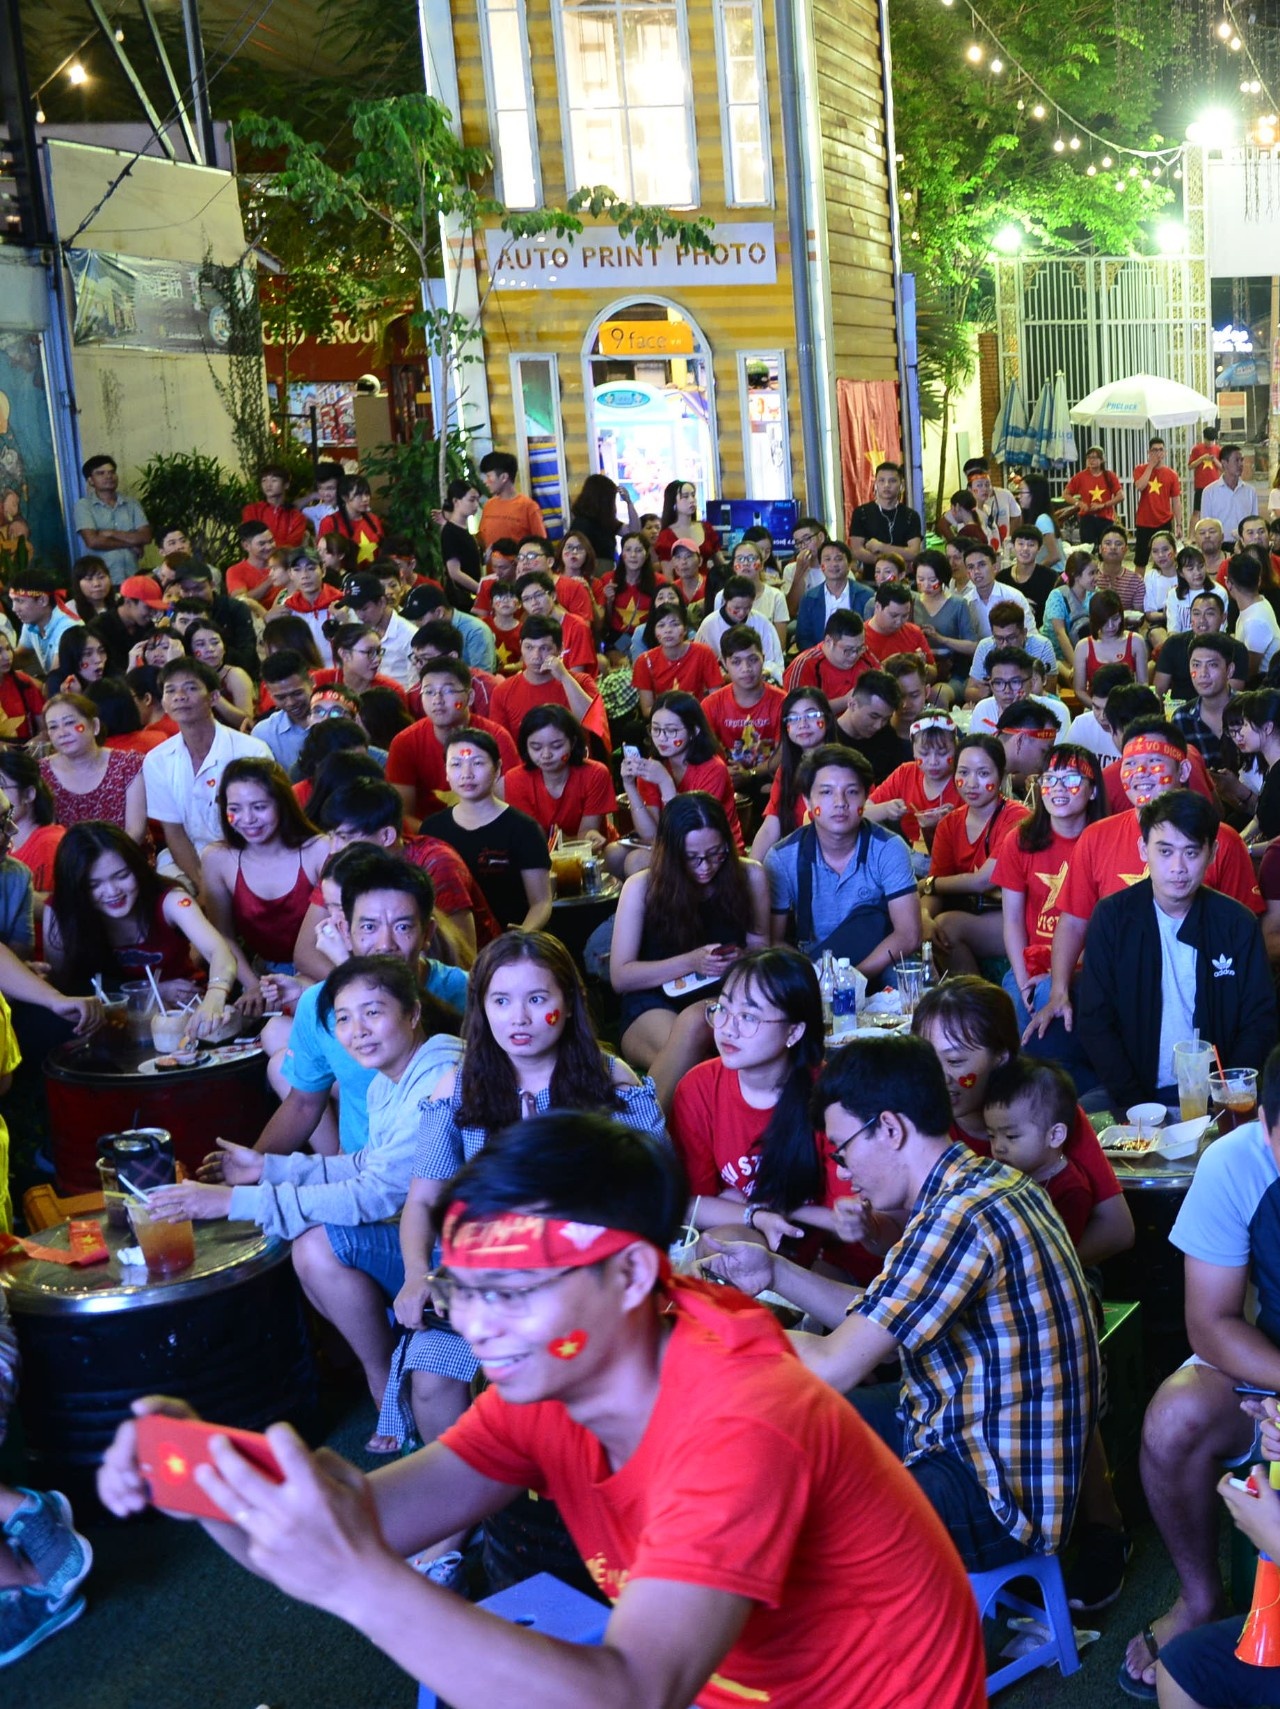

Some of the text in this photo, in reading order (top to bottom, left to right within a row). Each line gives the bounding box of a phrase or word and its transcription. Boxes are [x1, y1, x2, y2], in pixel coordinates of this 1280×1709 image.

[498, 241, 767, 270] AUTO PRINT PHOTO
